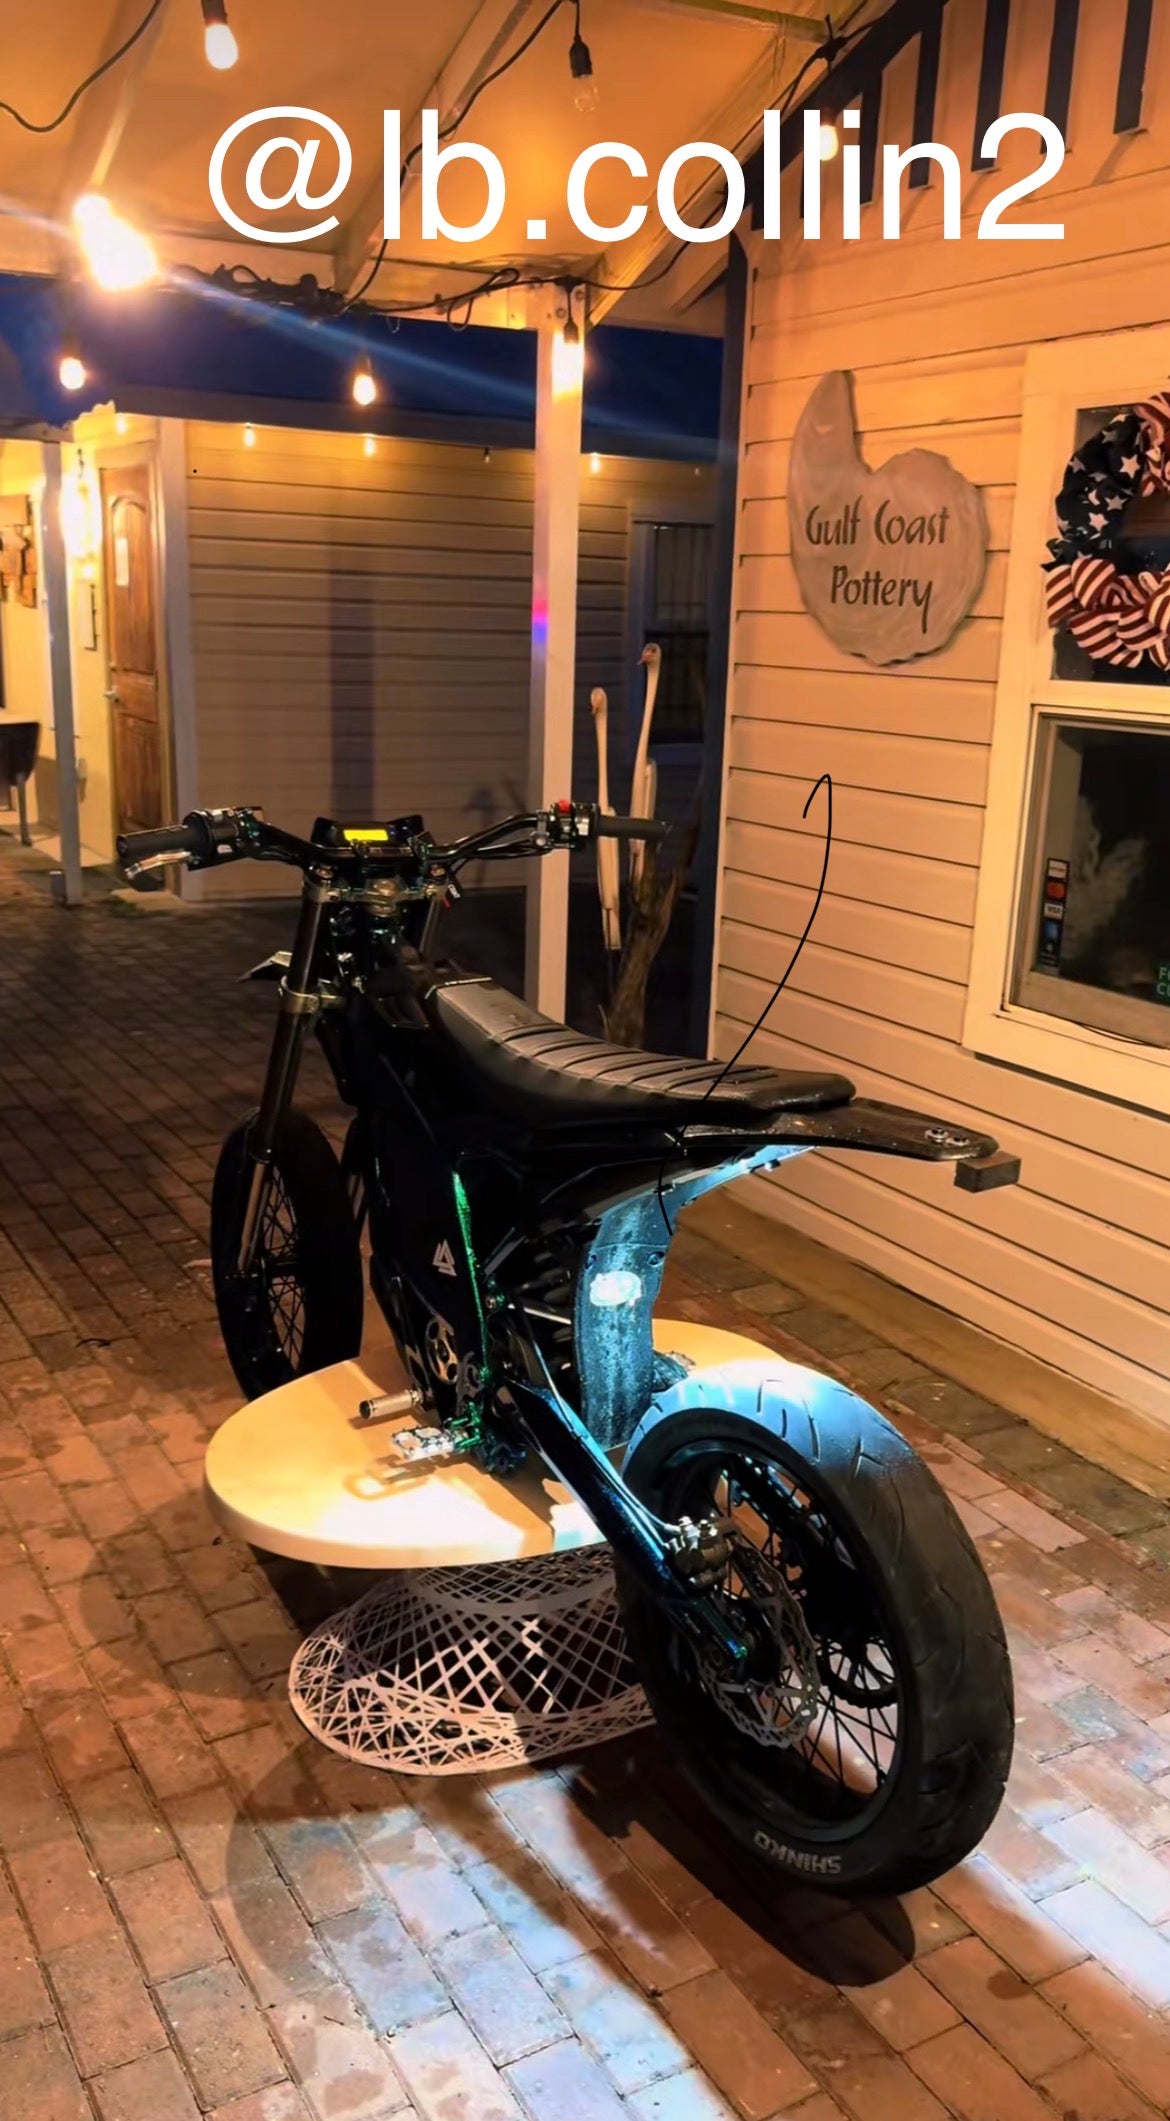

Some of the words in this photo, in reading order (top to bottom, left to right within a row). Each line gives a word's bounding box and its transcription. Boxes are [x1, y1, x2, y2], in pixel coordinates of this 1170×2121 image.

[805, 496, 862, 546] Gulf
[873, 499, 950, 546] Coast
[830, 564, 933, 635] Pottery
[754, 1830, 842, 1874] SHINKO
